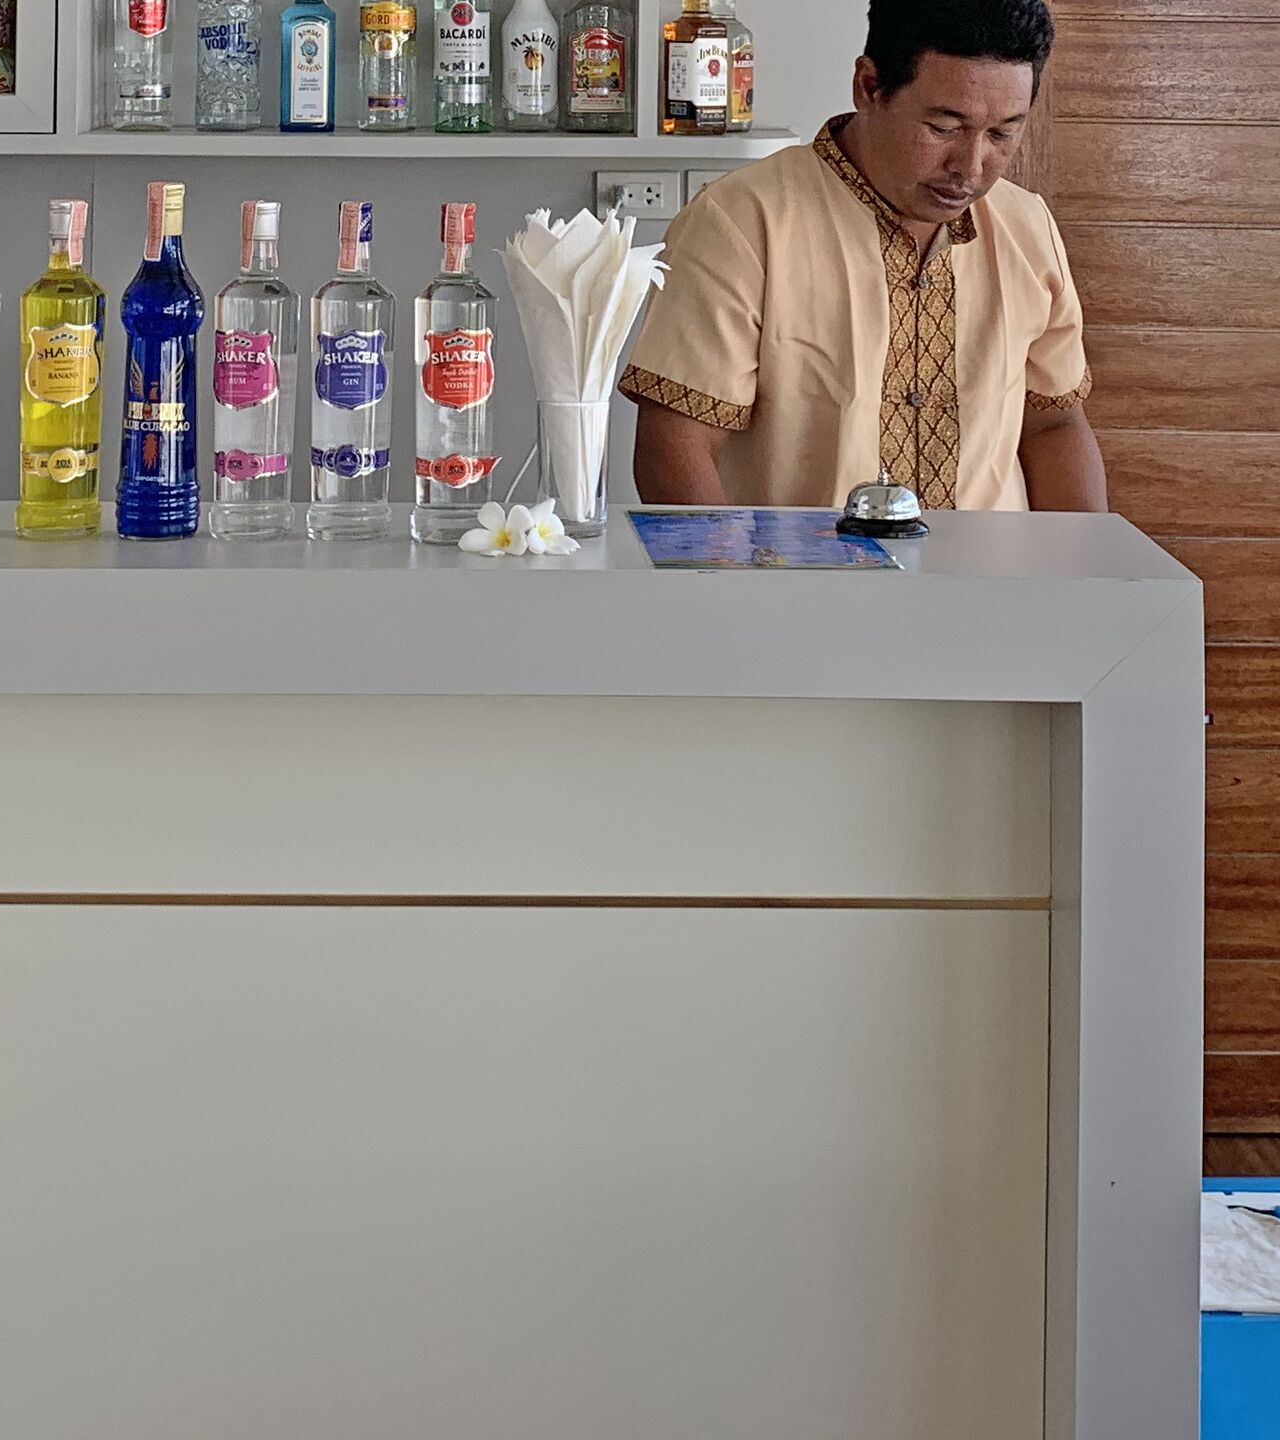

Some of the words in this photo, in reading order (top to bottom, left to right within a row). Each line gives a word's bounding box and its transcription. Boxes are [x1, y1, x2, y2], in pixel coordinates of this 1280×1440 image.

[199, 22, 247, 39] ABSOLUT
[439, 25, 486, 40] BACARDÍ
[510, 32, 557, 52] MALIBU
[696, 48, 711, 63] JIM
[217, 350, 267, 365] SHAKER
[324, 351, 379, 366] SHAKER
[431, 349, 486, 365] SHAKER
[229, 377, 247, 385] RUM
[444, 382, 474, 390] VODKA
